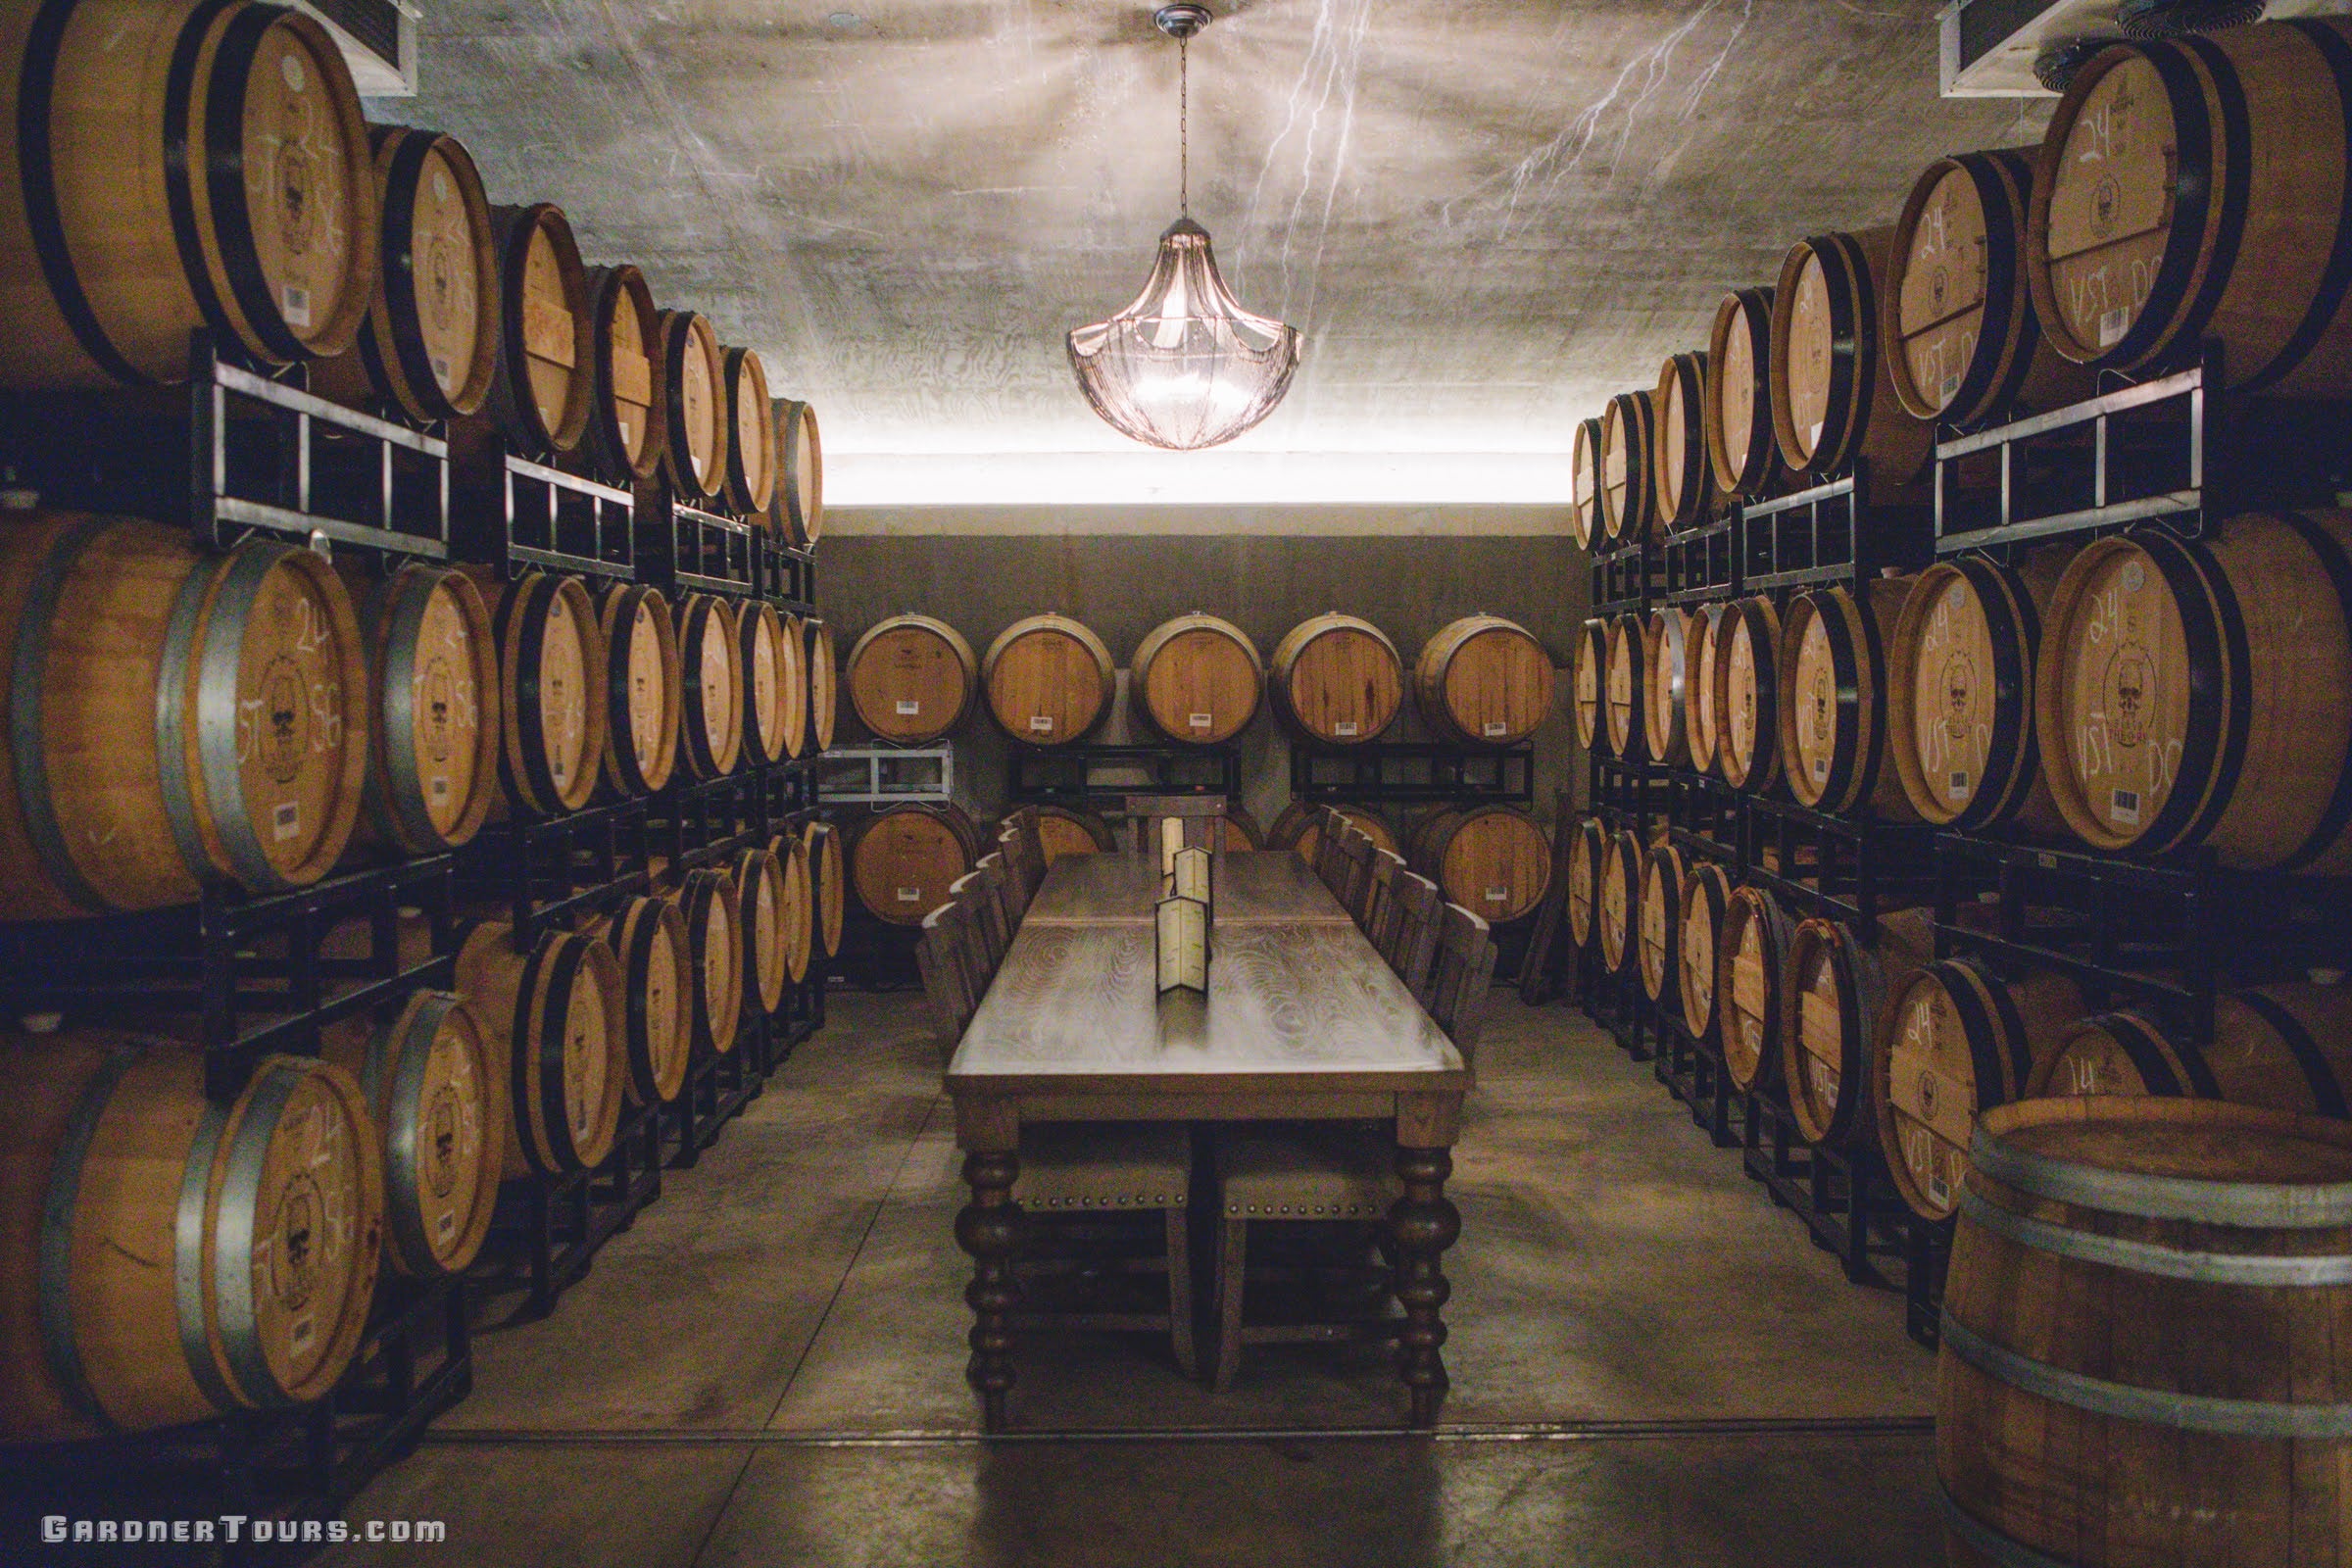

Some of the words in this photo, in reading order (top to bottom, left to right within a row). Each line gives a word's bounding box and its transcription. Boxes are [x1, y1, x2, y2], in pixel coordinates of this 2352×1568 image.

[2080, 102, 2110, 164] 24
[1919, 205, 1946, 260] 24
[1925, 601, 1950, 653] 24
[2089, 587, 2120, 644] 24
[2075, 710, 2114, 783] VST
[1906, 1001, 1933, 1050] 24
